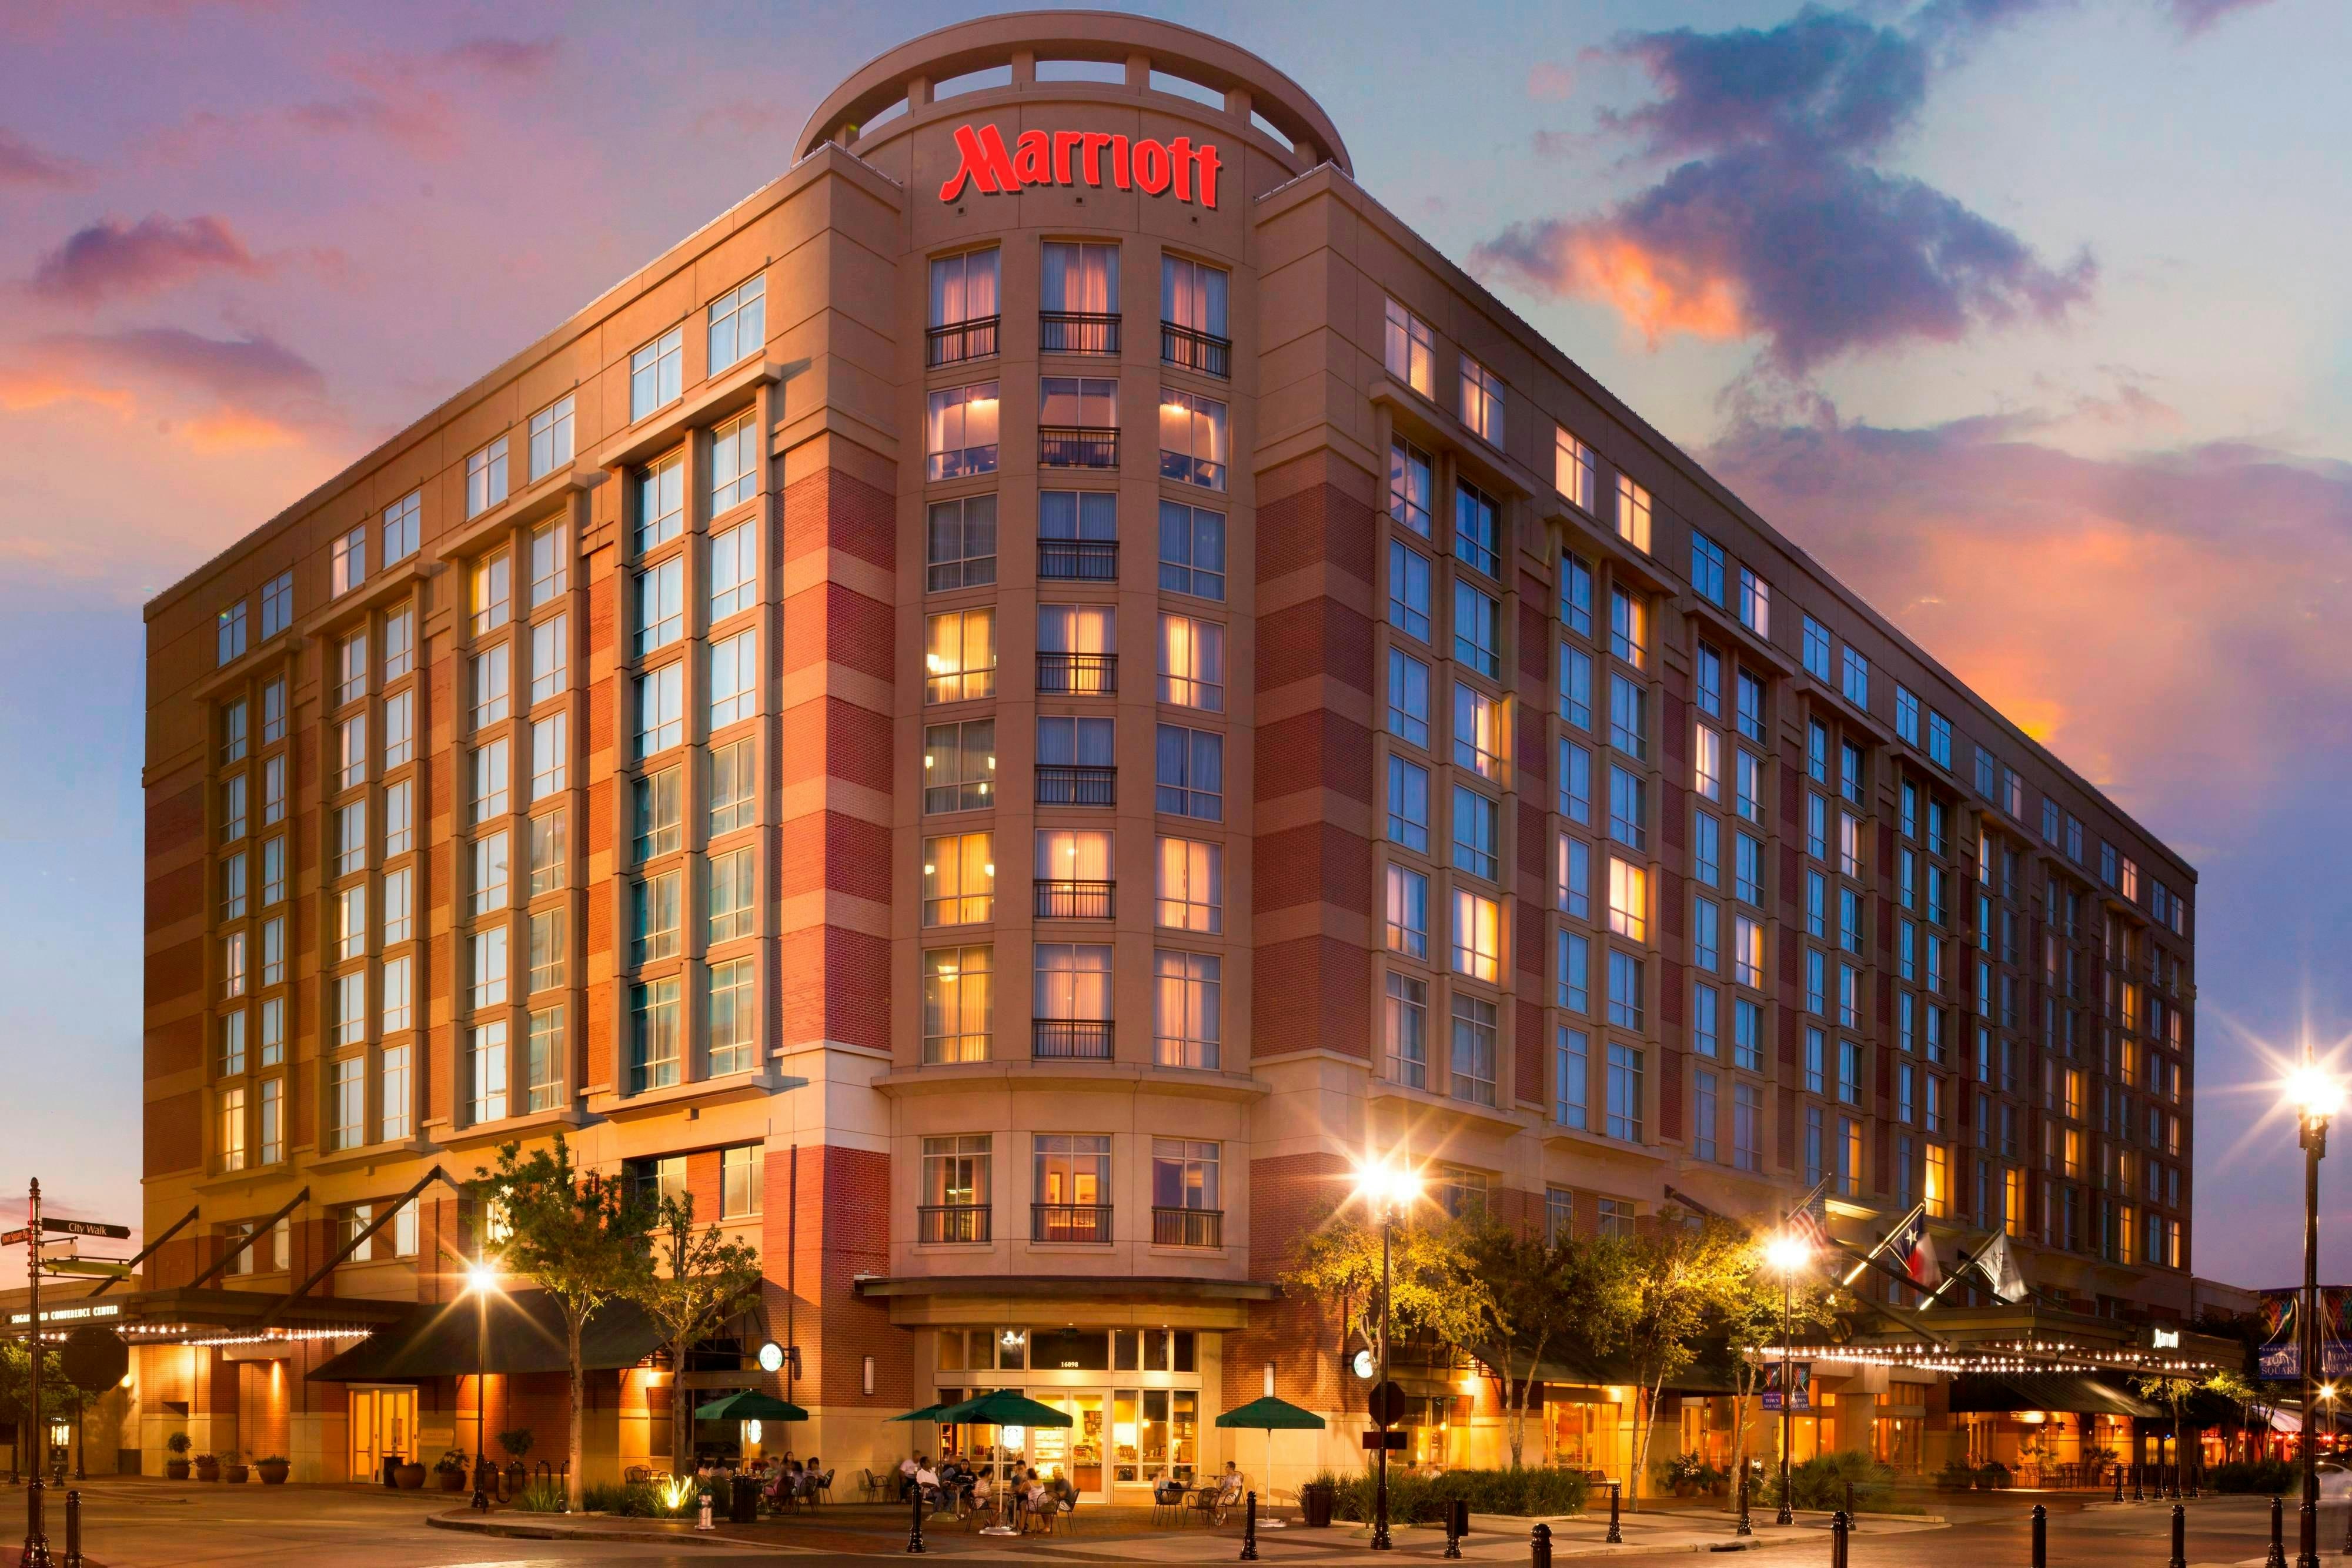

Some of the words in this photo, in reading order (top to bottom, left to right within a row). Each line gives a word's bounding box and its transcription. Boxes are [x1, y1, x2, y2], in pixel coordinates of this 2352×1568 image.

[939, 124, 1221, 207] Marriott
[68, 1223, 85, 1234] City
[86, 1225, 106, 1235] Walk
[11, 1313, 30, 1323] SUGAR
[51, 1308, 91, 1320] CONFERENCE
[93, 1305, 118, 1316] CENTER
[2261, 1366, 2299, 1375] SQUARE
